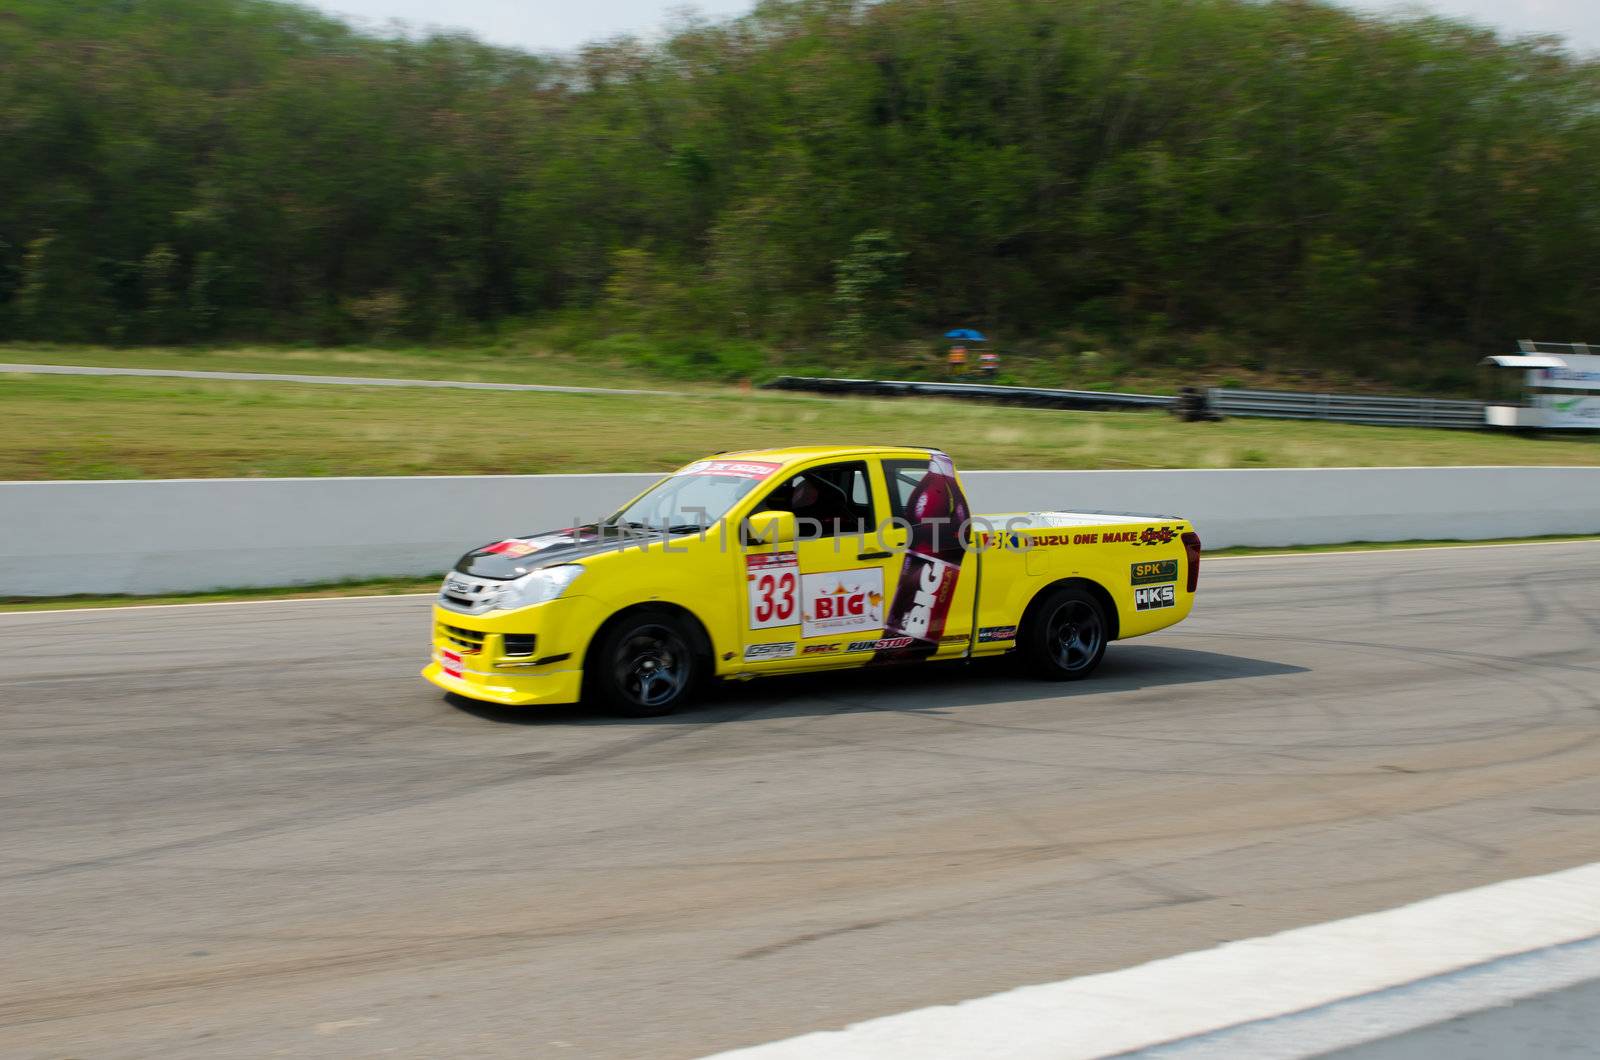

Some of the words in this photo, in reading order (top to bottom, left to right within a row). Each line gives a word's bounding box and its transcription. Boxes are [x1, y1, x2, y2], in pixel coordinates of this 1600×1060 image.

[1073, 533, 1098, 545] ONE
[1101, 532, 1137, 544] MAKE
[1136, 563, 1161, 577] SPK
[756, 572, 796, 622] 33
[815, 593, 865, 620] BIG
[905, 561, 946, 638] BIG
[1136, 587, 1174, 604] HKS
